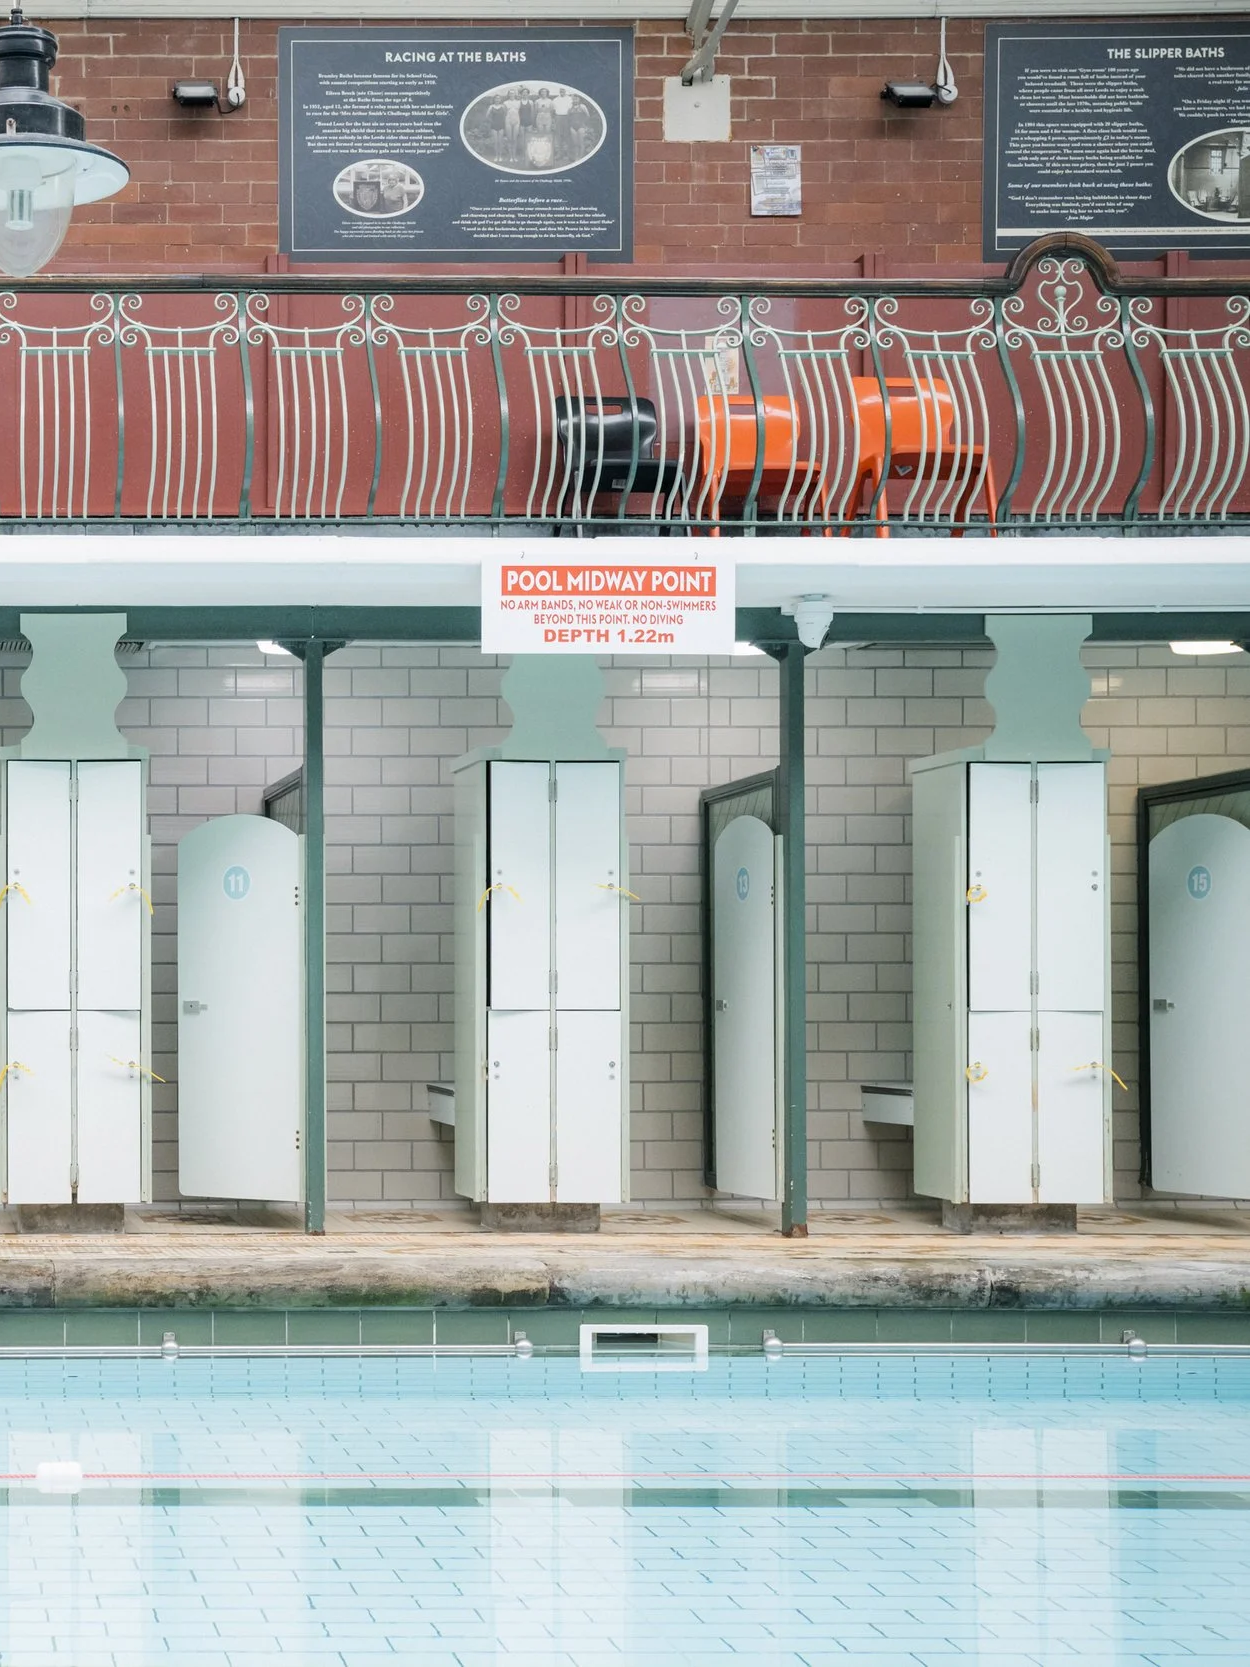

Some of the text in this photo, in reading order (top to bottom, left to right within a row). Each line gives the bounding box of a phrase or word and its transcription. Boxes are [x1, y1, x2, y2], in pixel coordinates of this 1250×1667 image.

[385, 52, 526, 62] RACING AT THE BATHS
[1107, 48, 1225, 59] THE SLIPPER BATHS
[508, 571, 712, 592] POOL MIDWAY POINT
[501, 600, 716, 610] NO ARM BANDS, NO WEAK OR NON-SWIMMERS
[534, 614, 683, 624] BEYOND THIS POINT. NO DIVING
[544, 629, 674, 643] DEPTH 1.22m
[229, 874, 243, 892] 11
[740, 874, 748, 892] 13
[1192, 874, 1207, 891] 15
